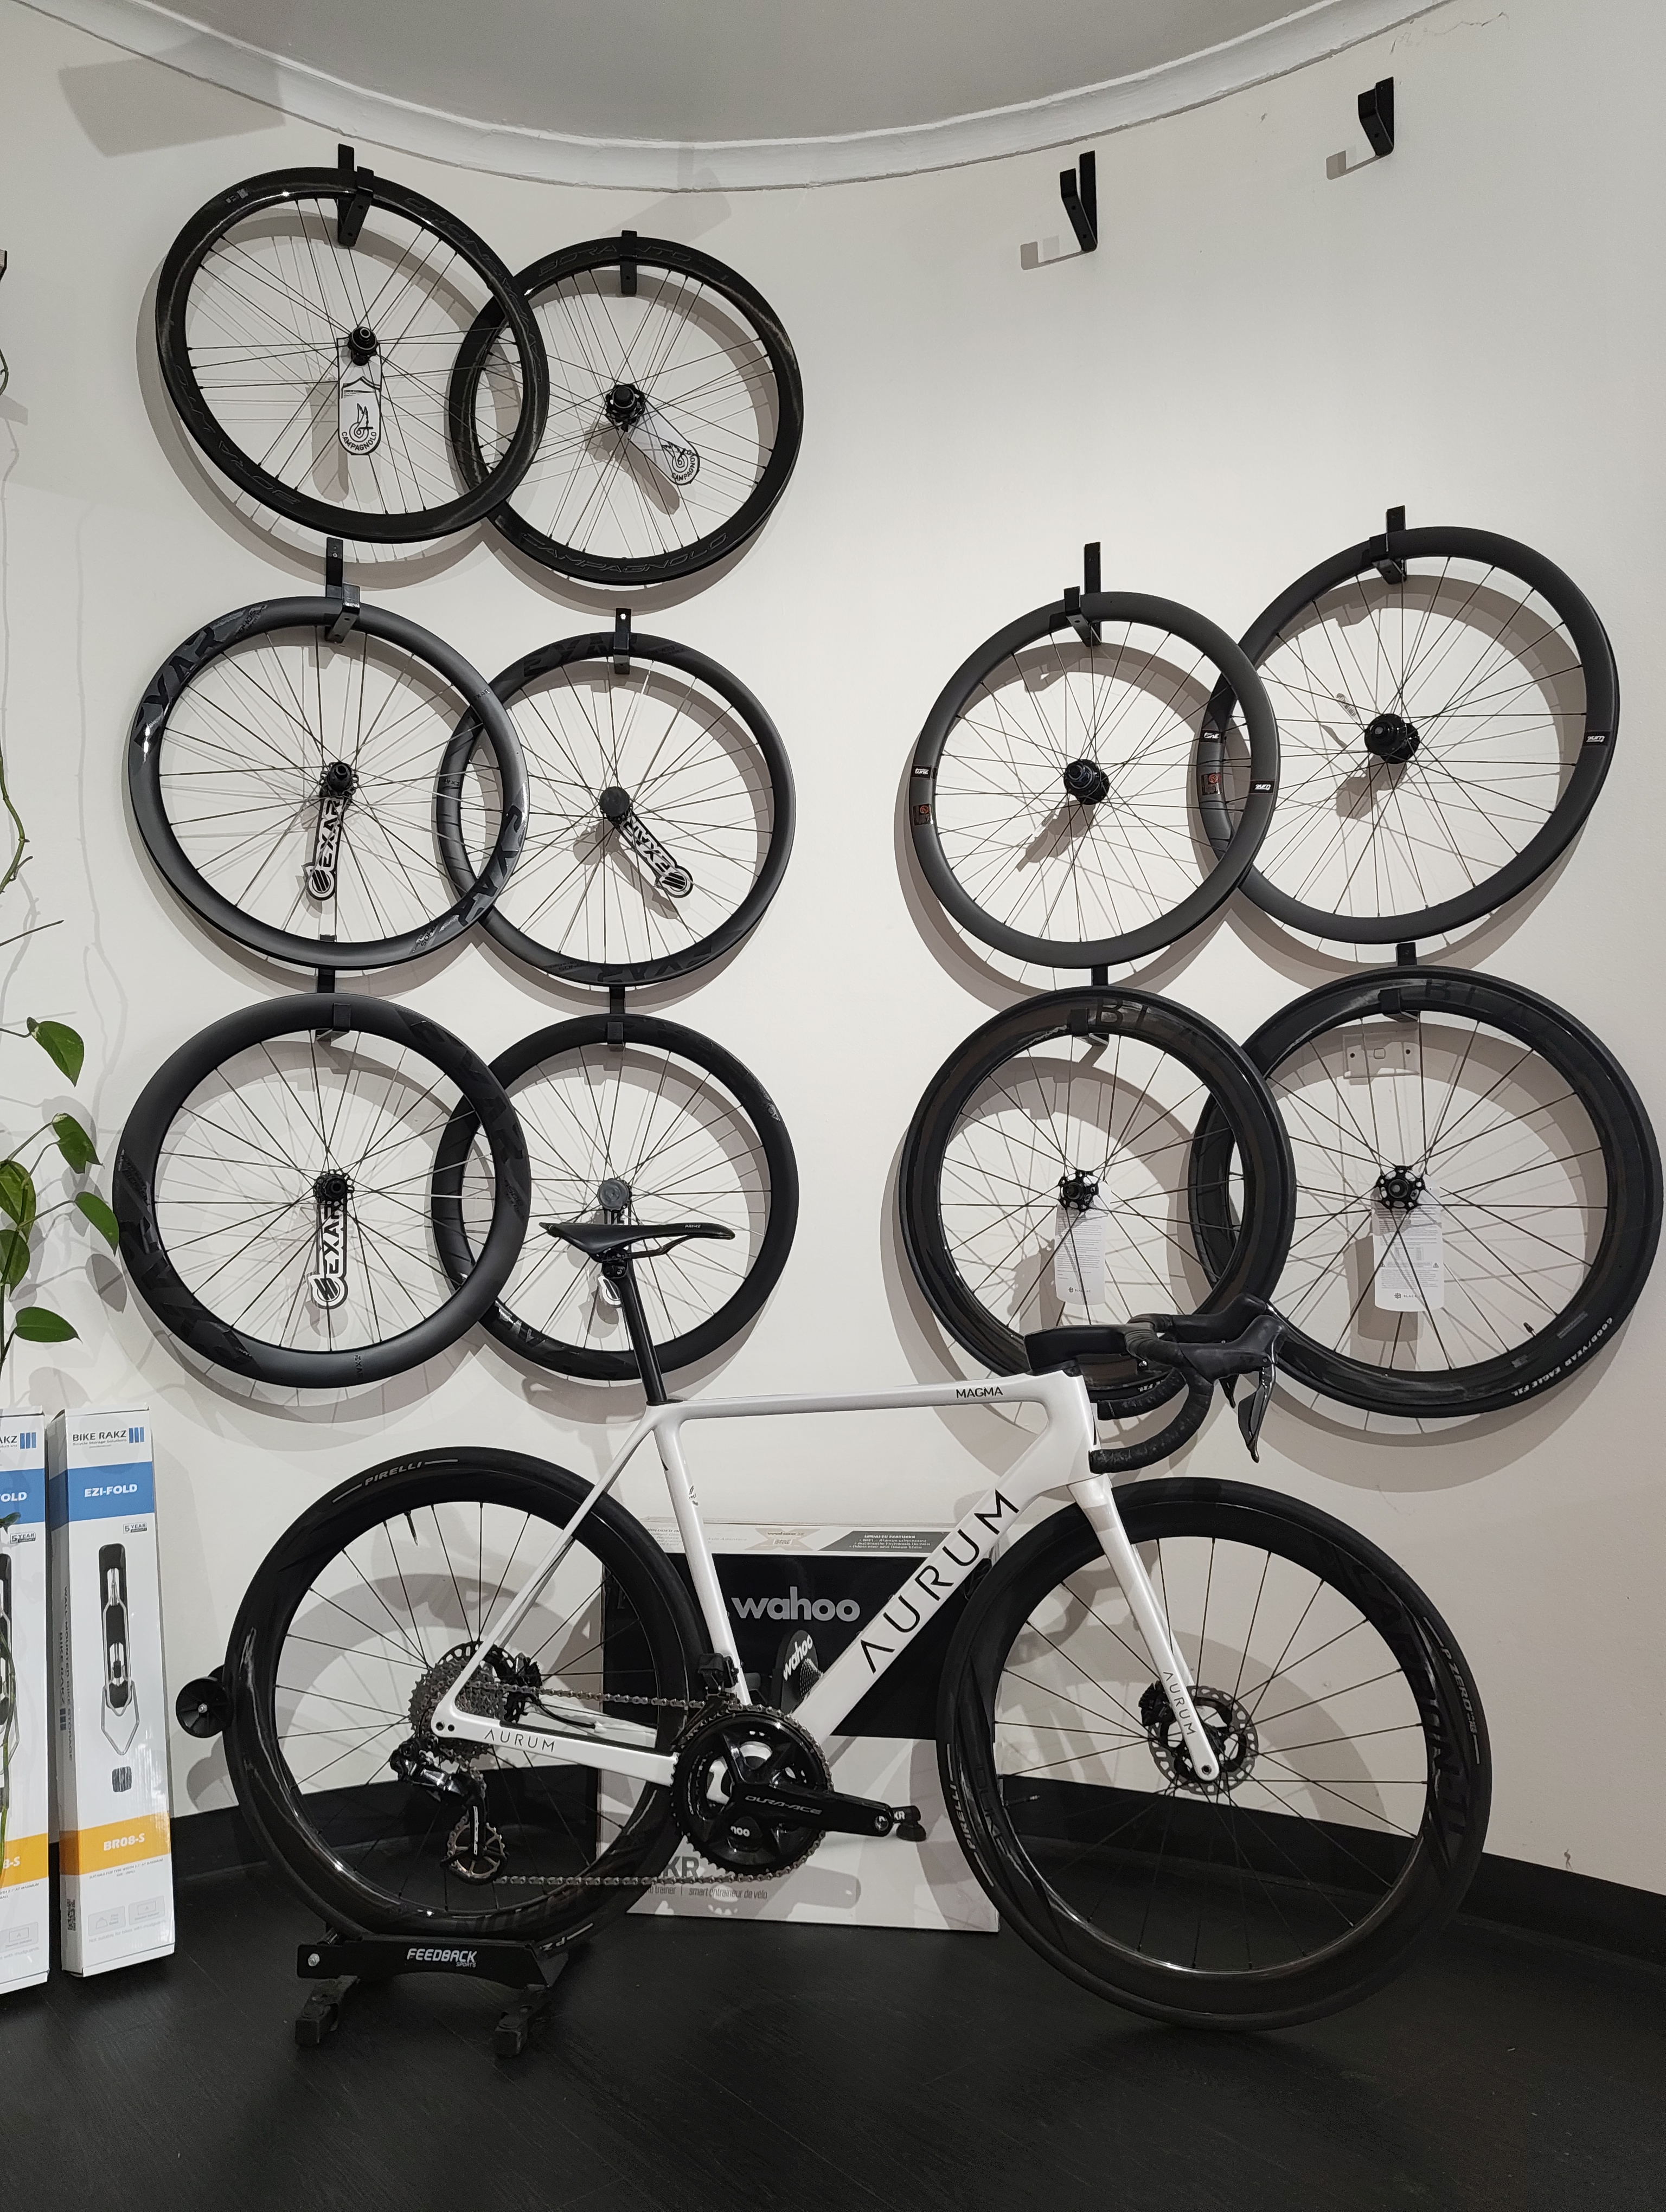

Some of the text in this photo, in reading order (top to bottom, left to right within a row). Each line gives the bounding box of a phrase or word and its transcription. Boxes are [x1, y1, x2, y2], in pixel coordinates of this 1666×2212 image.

[341, 431, 377, 451] CAMPAGNOLO
[521, 532, 728, 574] CAMPAGNOLO
[319, 800, 341, 867] EXAR
[1565, 1317, 1613, 1366] GOODYEAR
[1531, 1366, 1561, 1388] EAGLE
[956, 1386, 1003, 1399] MAGMA
[73, 1430, 127, 1442] BIKE RAKZ
[365, 1461, 422, 1486] PIRELLI
[84, 1484, 138, 1497] EZI-FOLD
[860, 1489, 1020, 1674] AURUM
[731, 1586, 860, 1622] wahoo
[783, 1634, 813, 1681] wahoo
[1449, 1663, 1473, 1712] ZERO
[1163, 1671, 1196, 1735] AURUM
[484, 1729, 555, 1753] AURUM
[745, 1795, 823, 1815] DURA-ACE
[950, 1781, 977, 1850] PIRELLI
[104, 1833, 145, 1851] BR08-S
[655, 1886, 675, 1895] trainer
[689, 1887, 708, 1897] smart
[407, 1948, 477, 1963] FEEDBACK
